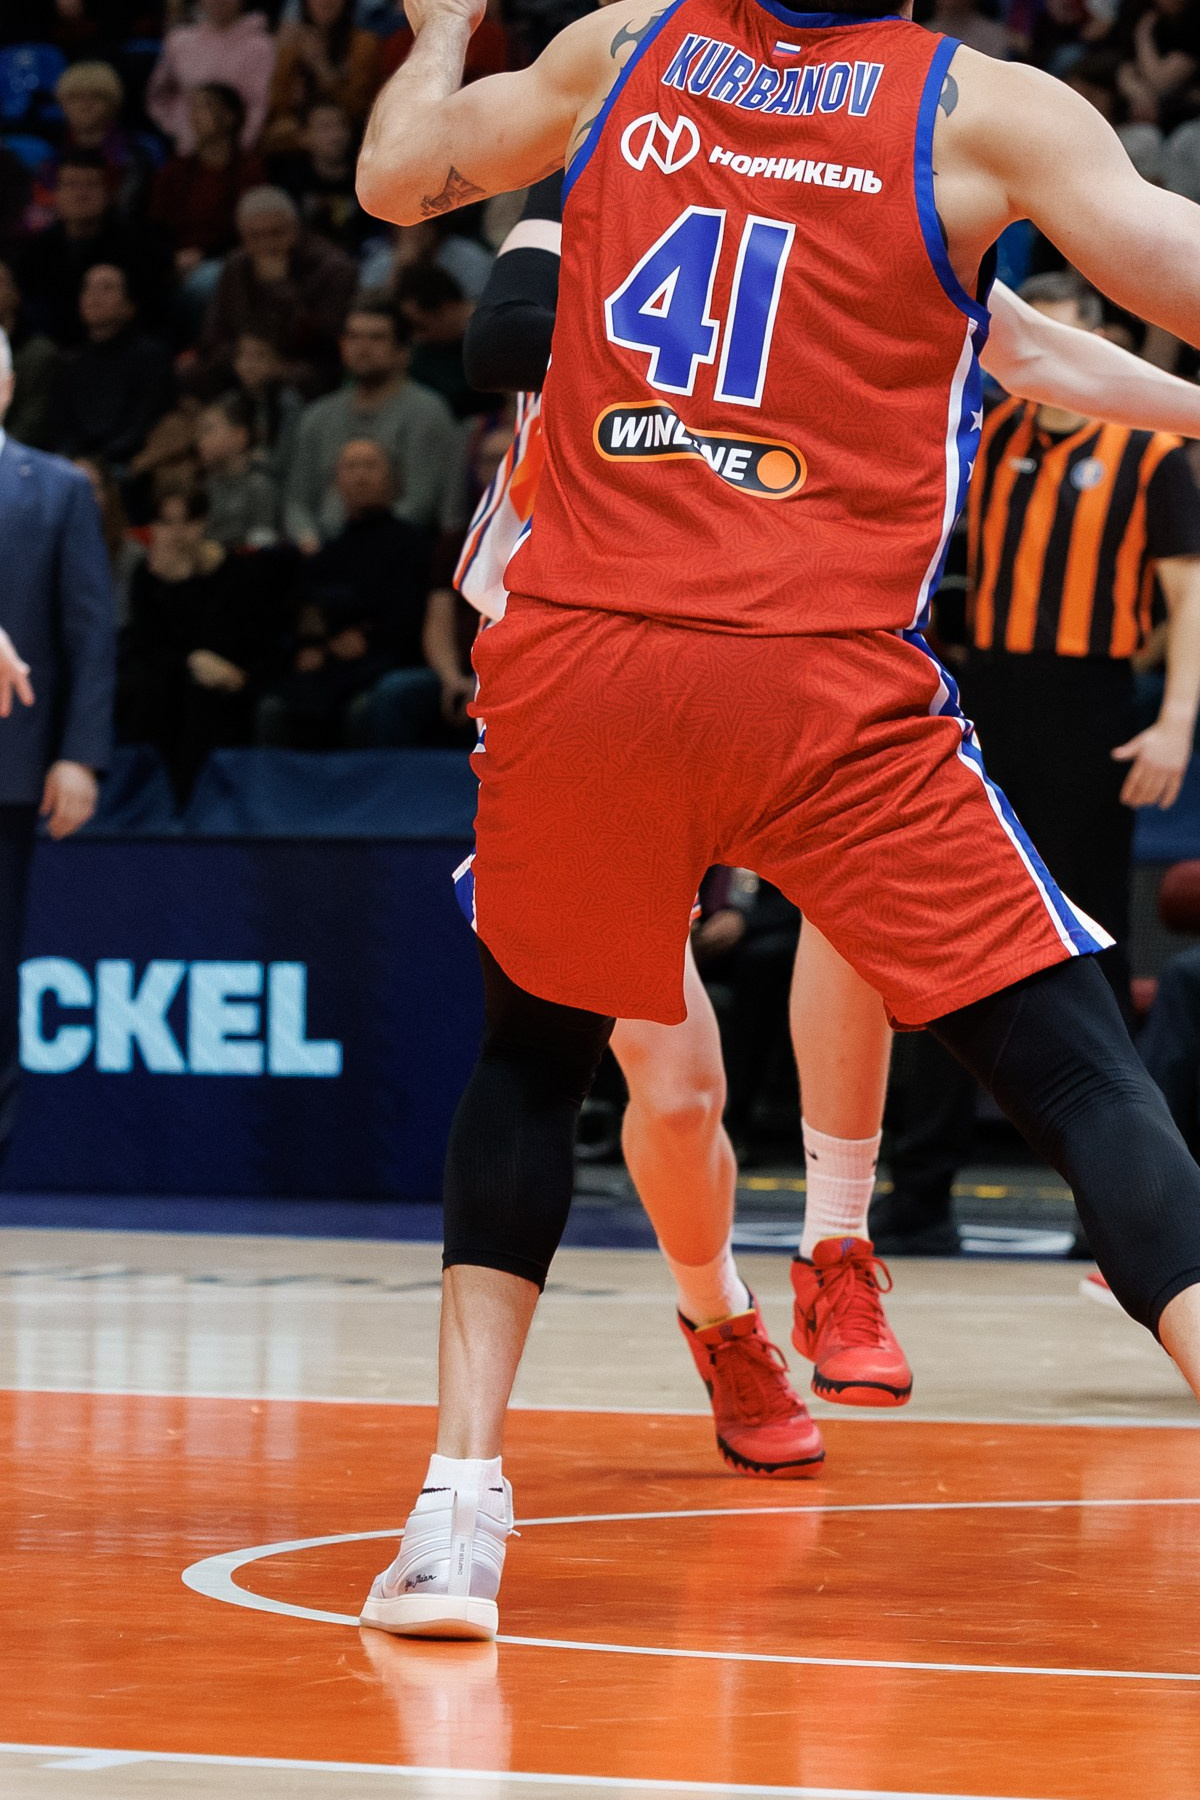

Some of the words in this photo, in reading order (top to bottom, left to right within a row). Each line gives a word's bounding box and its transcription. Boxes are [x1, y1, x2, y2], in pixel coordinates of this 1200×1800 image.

[661, 33, 885, 118] KURBANOV
[708, 145, 883, 194] НОРНИКЕЛЬ
[604, 205, 797, 408] 41
[609, 413, 753, 481] WINLNE
[18, 956, 343, 1077] CKEL
